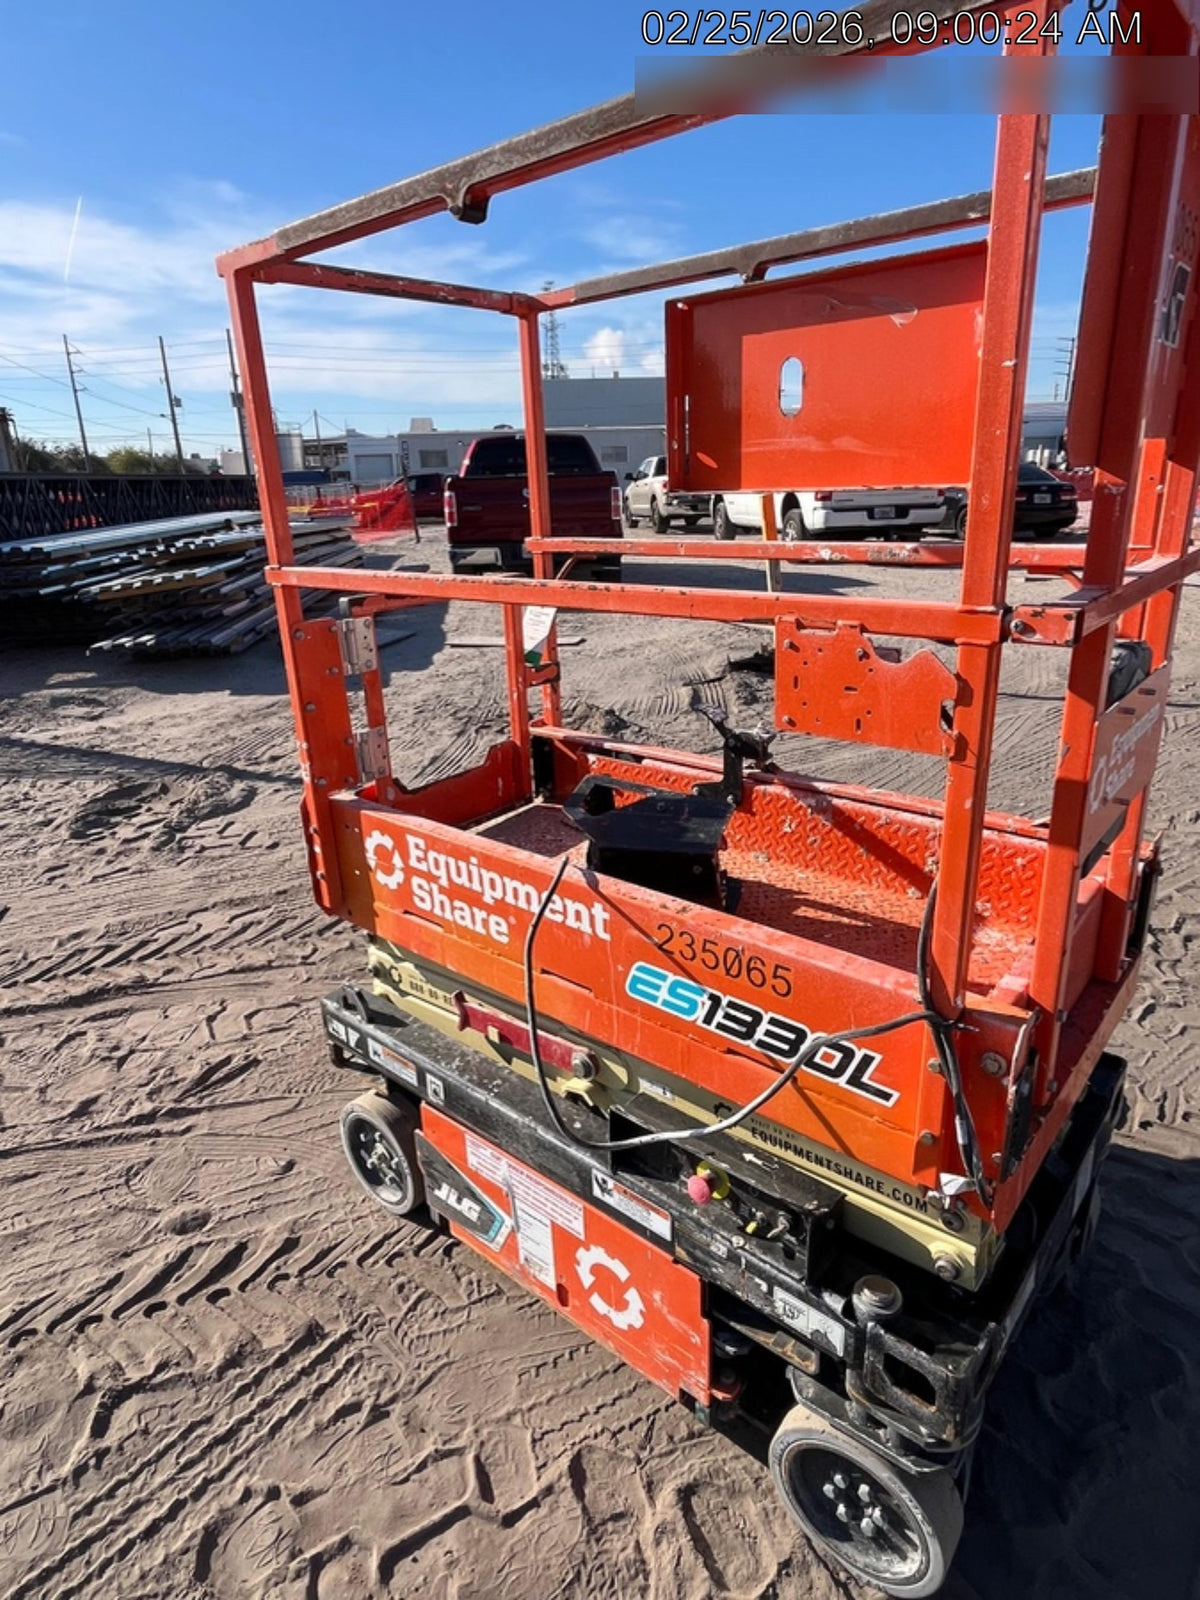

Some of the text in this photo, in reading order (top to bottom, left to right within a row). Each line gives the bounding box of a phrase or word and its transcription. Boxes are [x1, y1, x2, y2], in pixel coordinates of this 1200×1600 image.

[405, 834, 611, 941] Equipment
[411, 876, 509, 944] Share
[656, 923, 793, 998] 235065
[627, 963, 896, 1105] ES1330L
[434, 1182, 481, 1222] JLG
[751, 1127, 928, 1212] EQUIPMENTSHARE.COM
